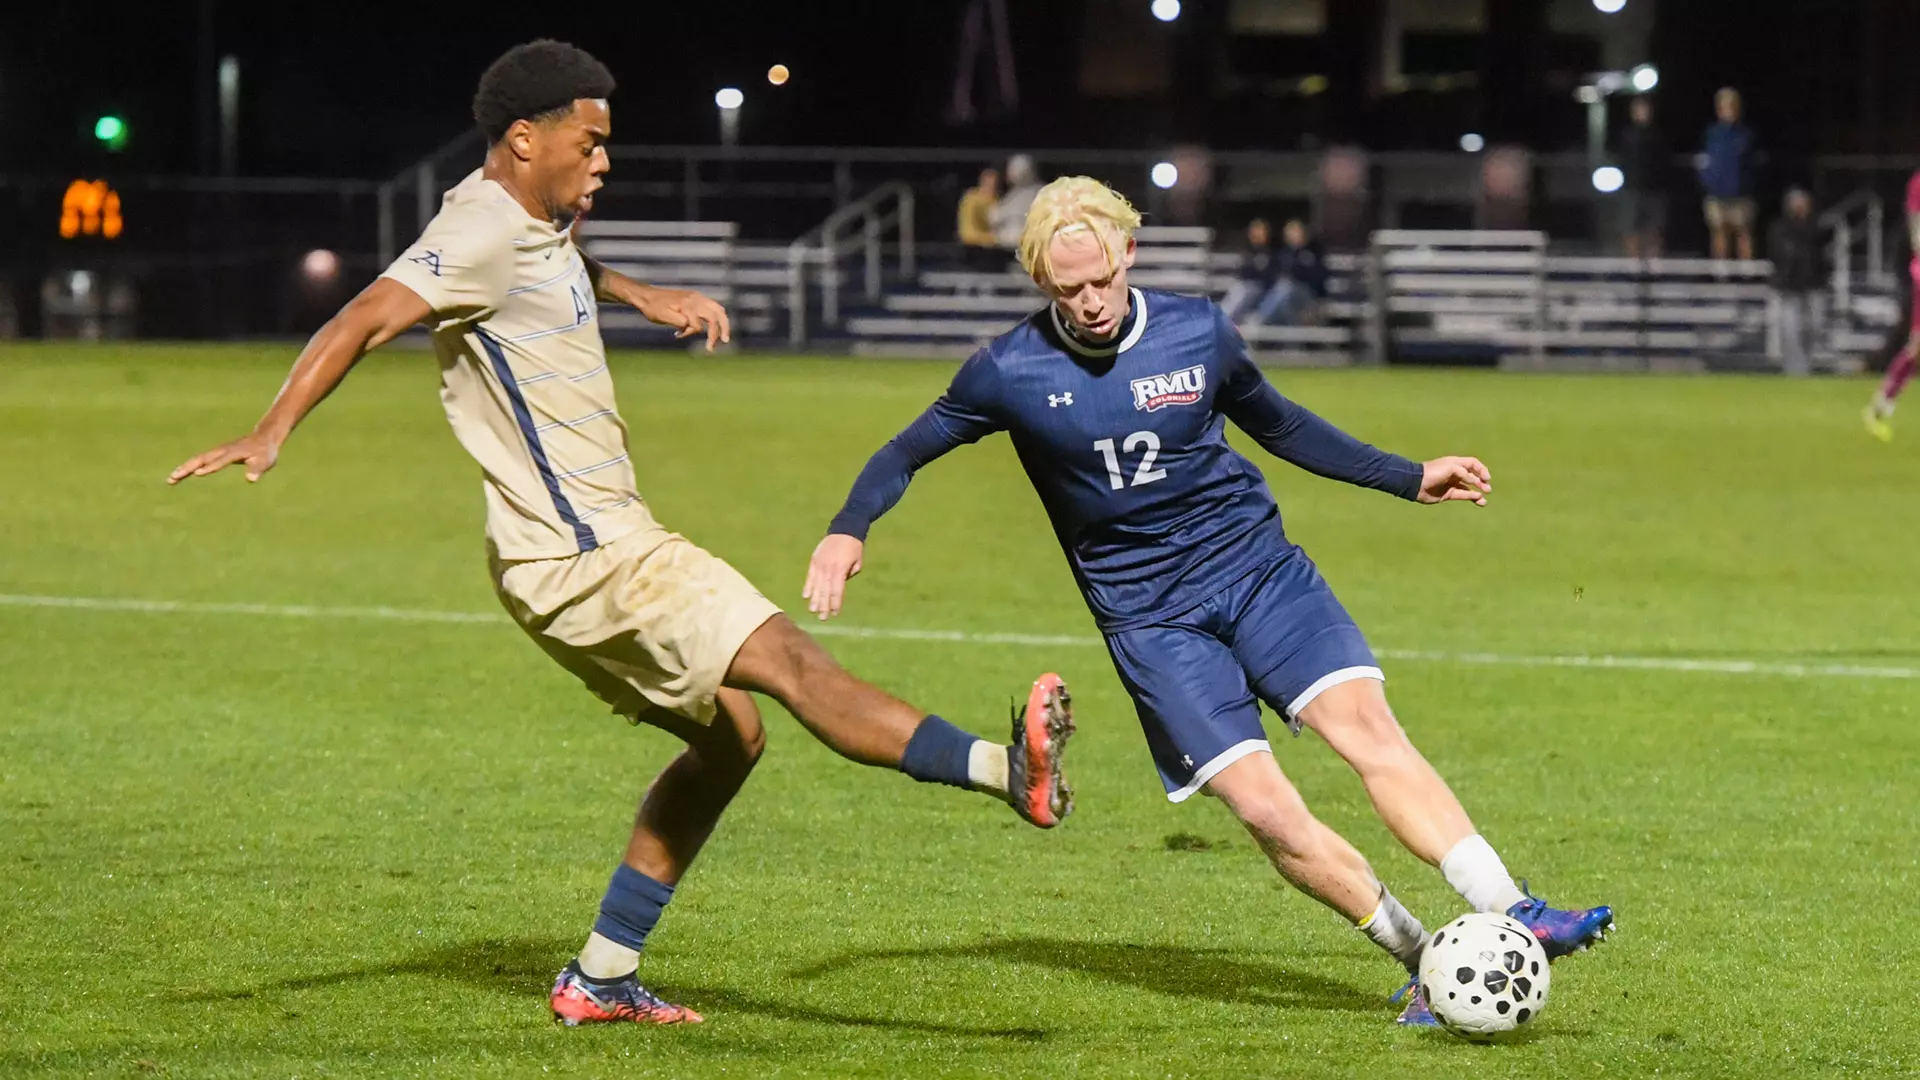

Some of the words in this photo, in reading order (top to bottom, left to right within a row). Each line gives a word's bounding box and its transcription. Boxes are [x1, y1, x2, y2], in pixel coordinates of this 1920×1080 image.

[1132, 366, 1204, 407] RMU
[1149, 392, 1198, 407] COLONIALS
[1093, 430, 1168, 491] 12
